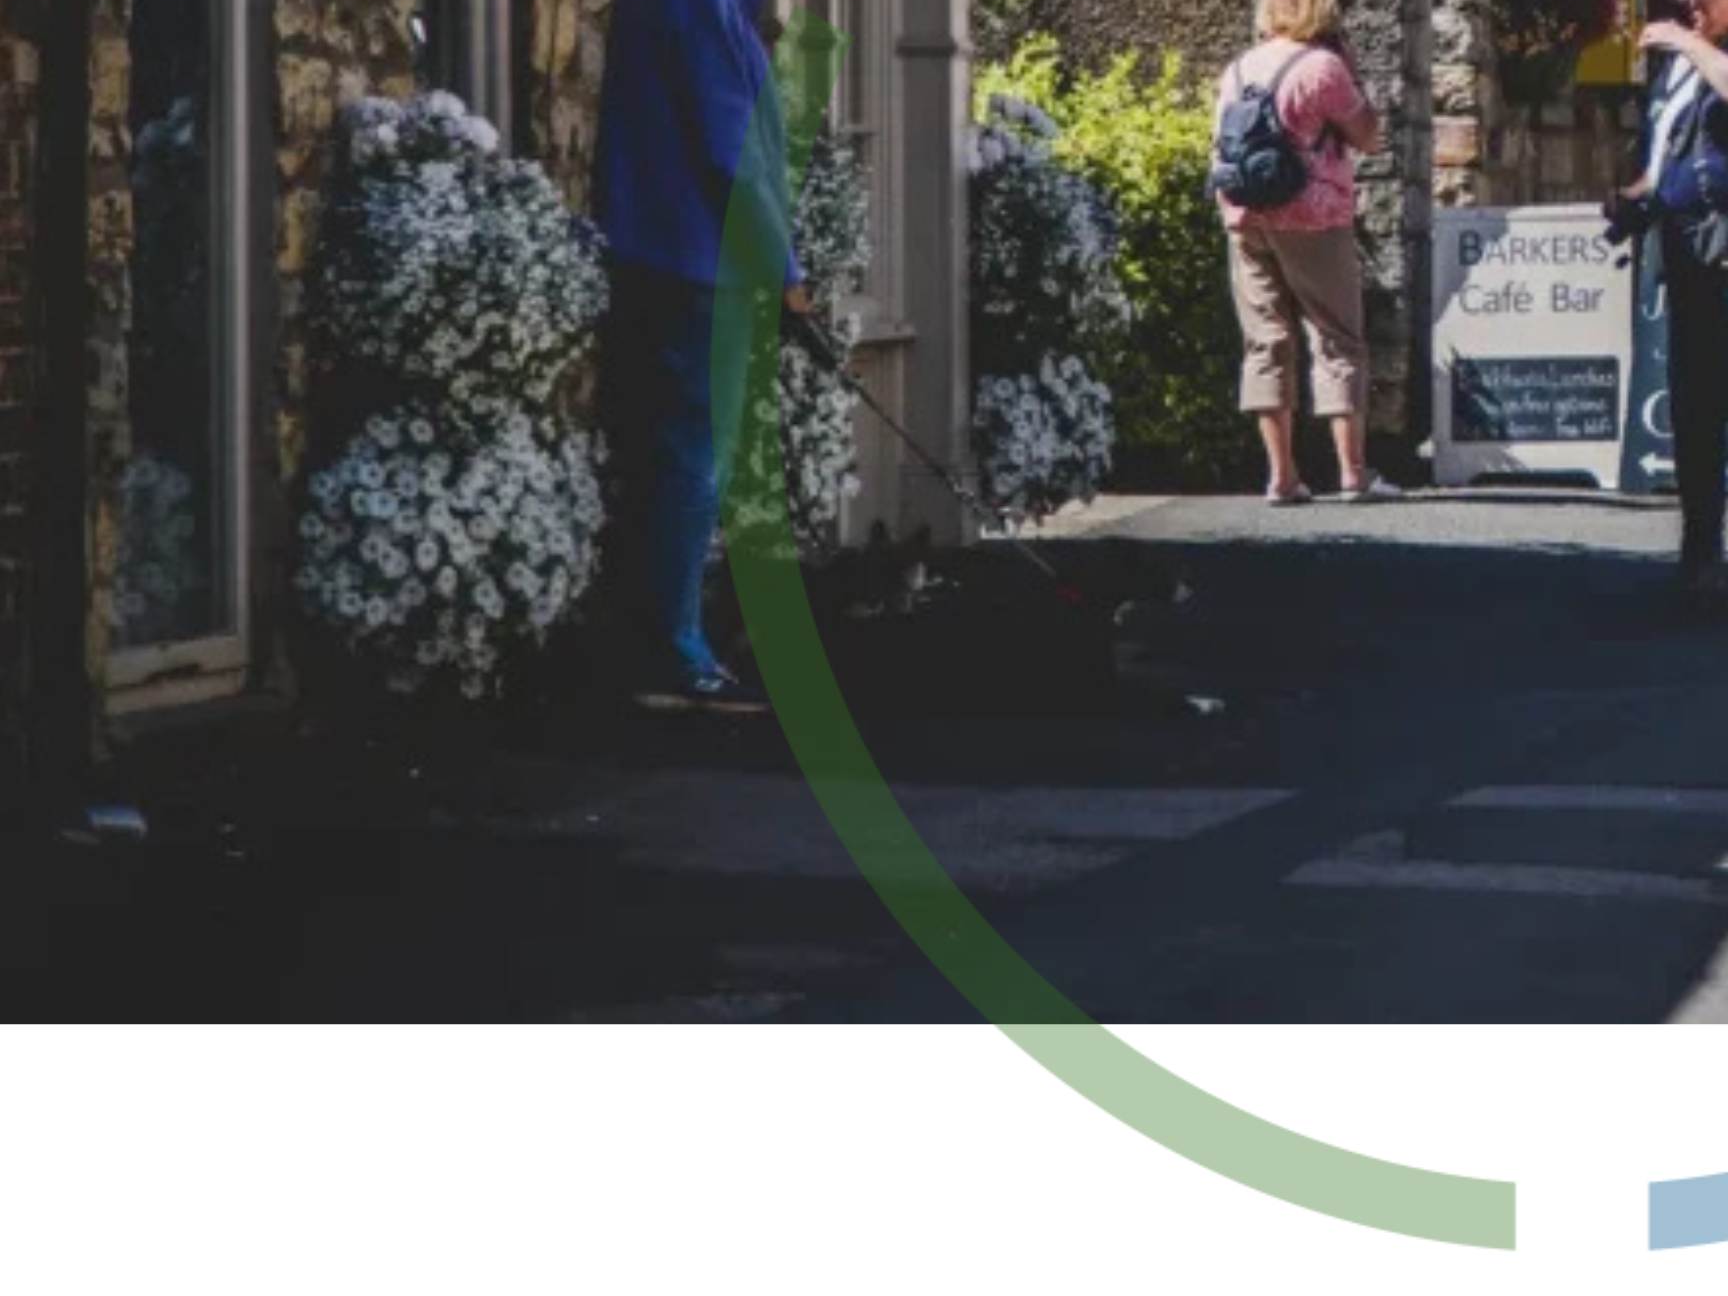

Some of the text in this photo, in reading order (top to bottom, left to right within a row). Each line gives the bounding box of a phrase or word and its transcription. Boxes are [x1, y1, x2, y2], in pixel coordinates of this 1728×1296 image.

[1458, 229, 1609, 266] BARKERS
[1458, 280, 1534, 314] Café
[1551, 283, 1605, 313] Bar
